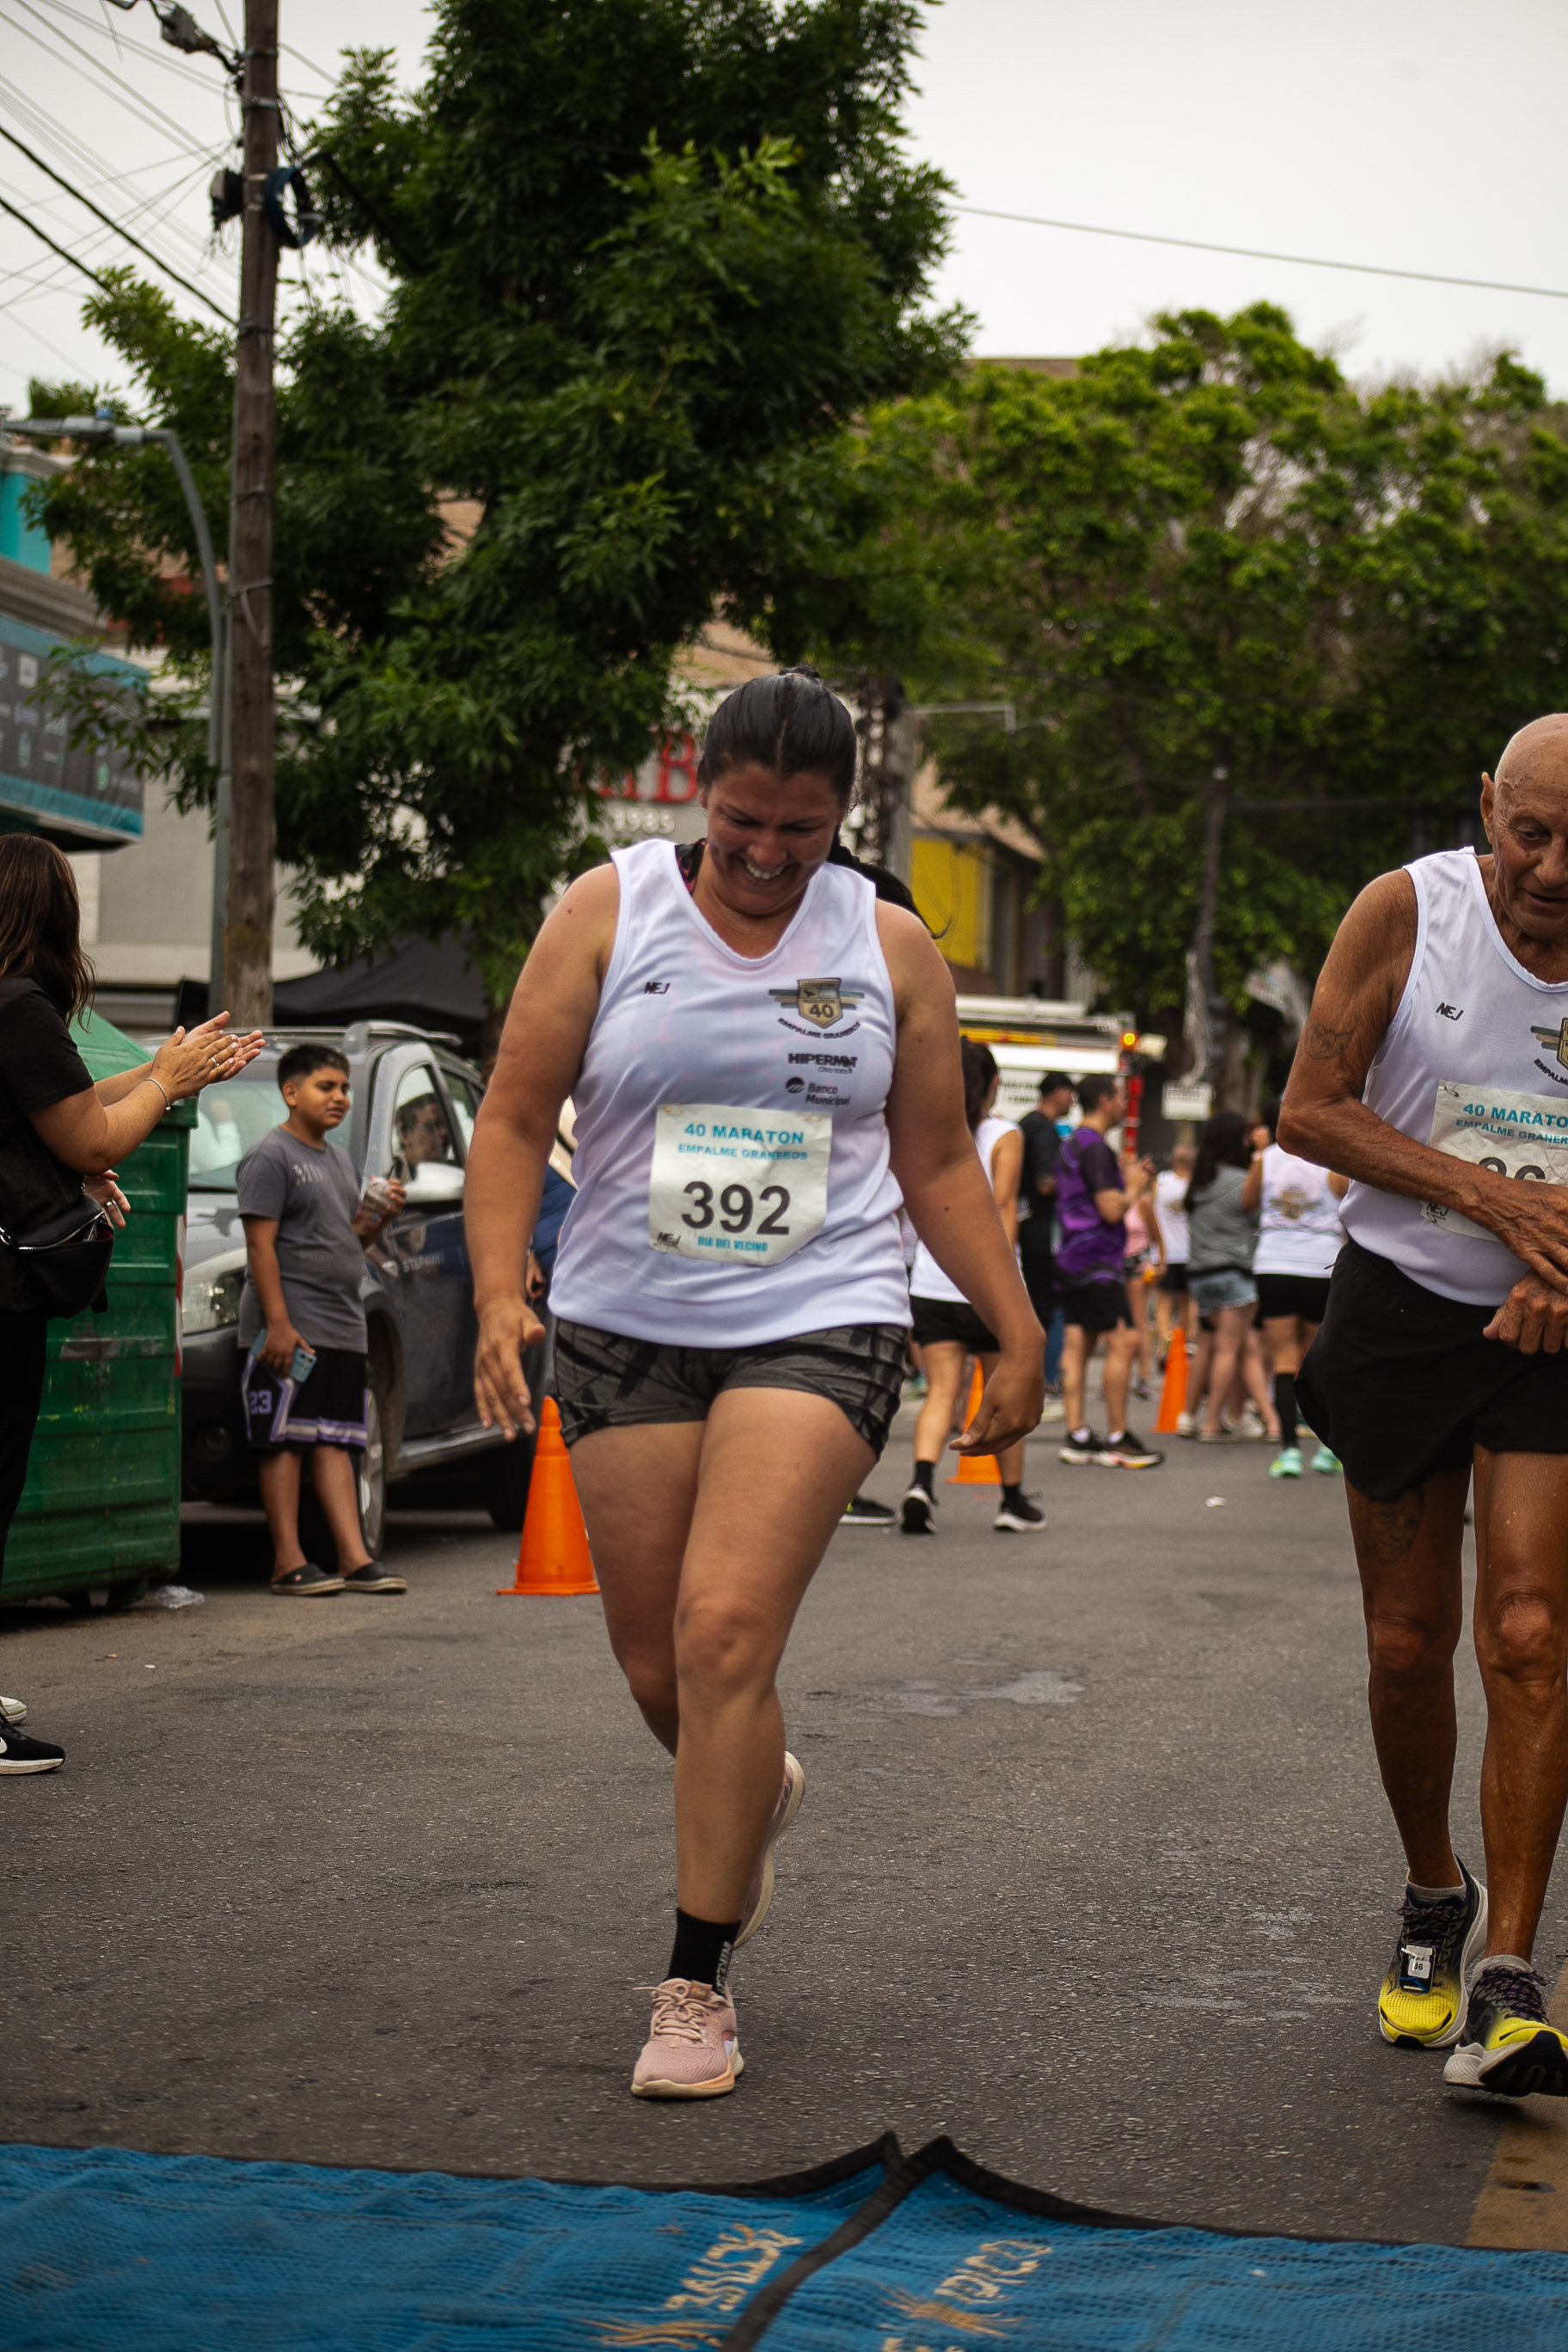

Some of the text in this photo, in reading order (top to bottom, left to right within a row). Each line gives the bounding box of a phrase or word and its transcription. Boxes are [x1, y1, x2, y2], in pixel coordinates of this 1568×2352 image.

[809, 1004, 835, 1019] 40
[1436, 1002, 1464, 1021] NEJ
[808, 1082, 838, 1094] Banco
[805, 1093, 852, 1107] Municipal
[1463, 1103, 1485, 1117] 40
[684, 1123, 805, 1145] 40 MARATON
[1455, 1119, 1516, 1138] EMPALME
[678, 1143, 808, 1161] EMPALME GRANEROS
[681, 1180, 791, 1235] 392
[697, 1235, 714, 1246] DIA
[715, 1238, 731, 1250] DEL
